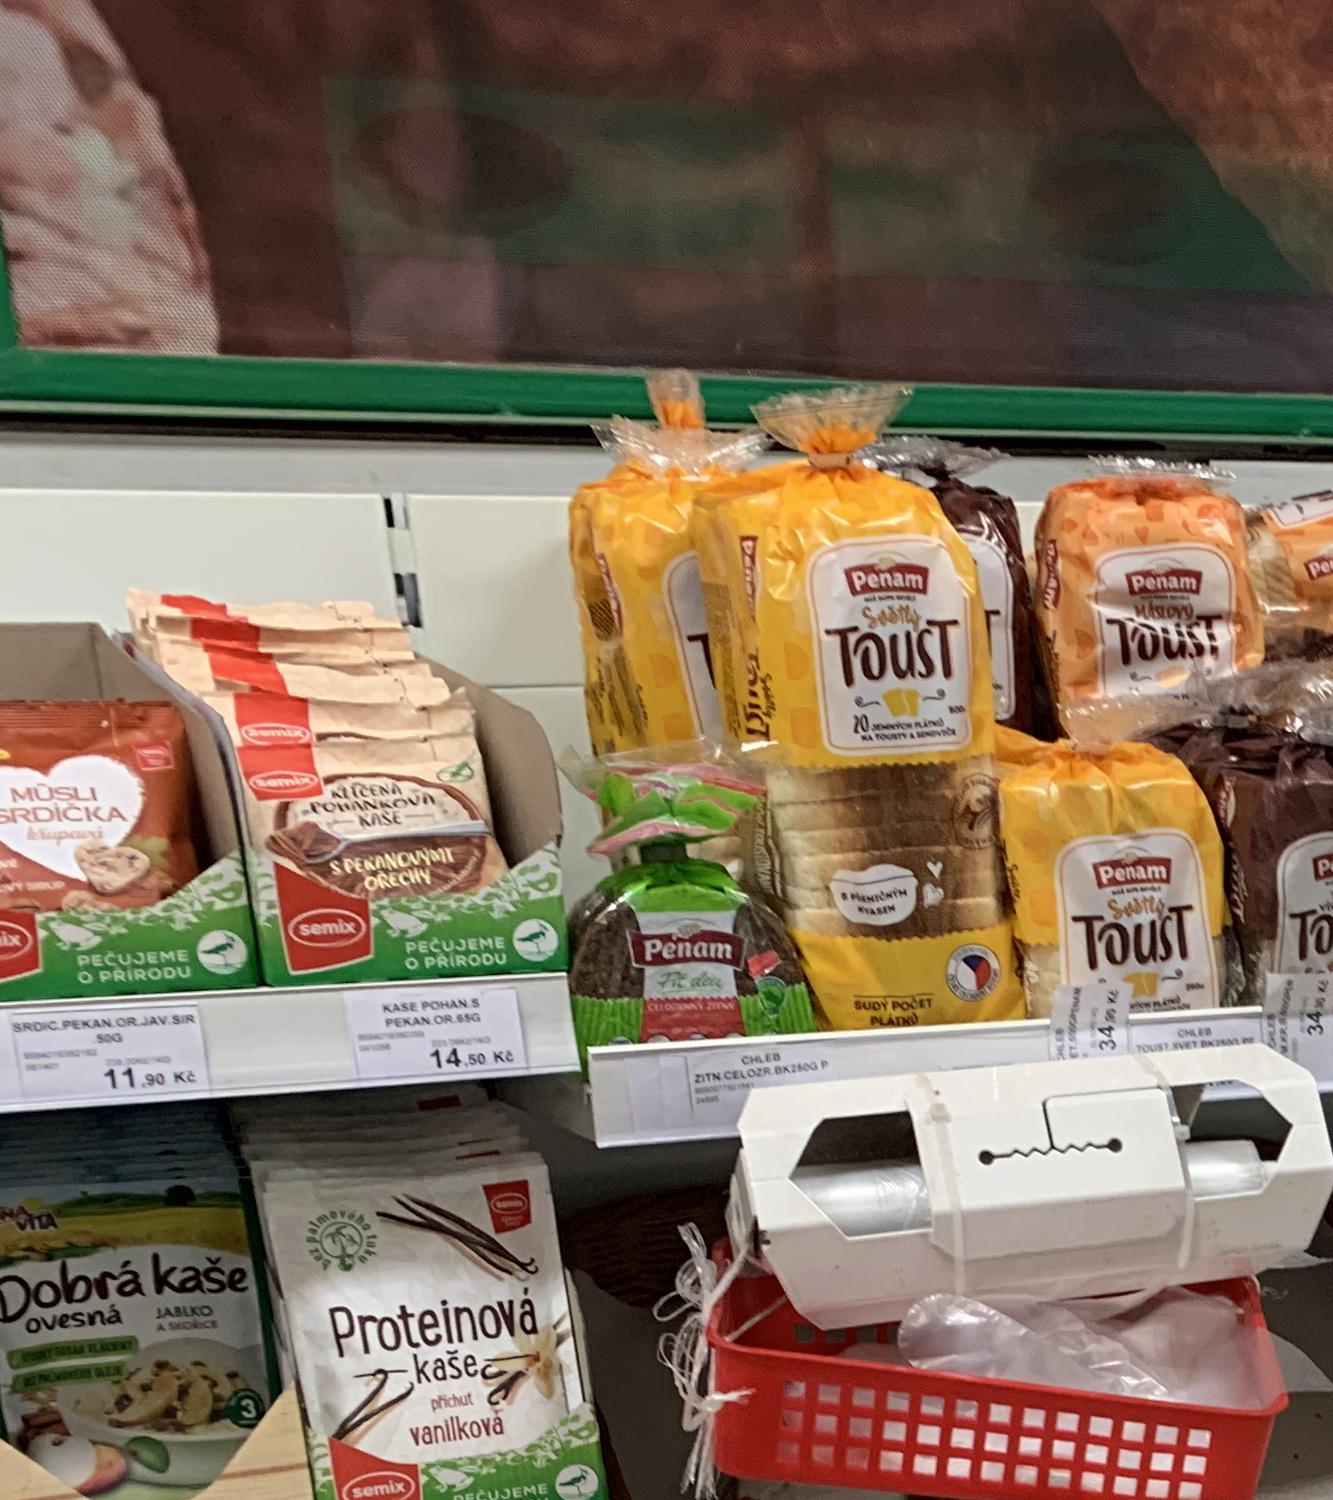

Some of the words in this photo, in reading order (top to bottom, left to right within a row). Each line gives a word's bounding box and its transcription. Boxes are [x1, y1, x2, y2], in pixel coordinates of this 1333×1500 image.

[852, 569, 924, 591] Penam
[1134, 573, 1196, 593] Penam
[1101, 863, 1166, 884] Penam
[299, 919, 353, 937] semix
[405, 935, 505, 954] PEČUJEME
[645, 939, 732, 961] Penam
[77, 949, 189, 966] PEČUJEME
[405, 957, 417, 969] O
[424, 952, 507, 967] PŘÍRODU
[78, 970, 92, 983] O
[98, 964, 192, 980] PŘÍRODU
[382, 1001, 416, 1013] KASE
[741, 1053, 780, 1065] CHLEB
[0, 1260, 142, 1324] Dobrá
[152, 1252, 248, 1294] kaše
[25, 1308, 122, 1334] ovesná
[156, 1305, 214, 1319] JABLKO
[330, 1289, 538, 1358] Proteinová
[415, 1352, 479, 1384] kaše
[240, 1400, 256, 1419] 3
[410, 1408, 505, 1448] vanilková
[352, 1478, 406, 1499] semix
